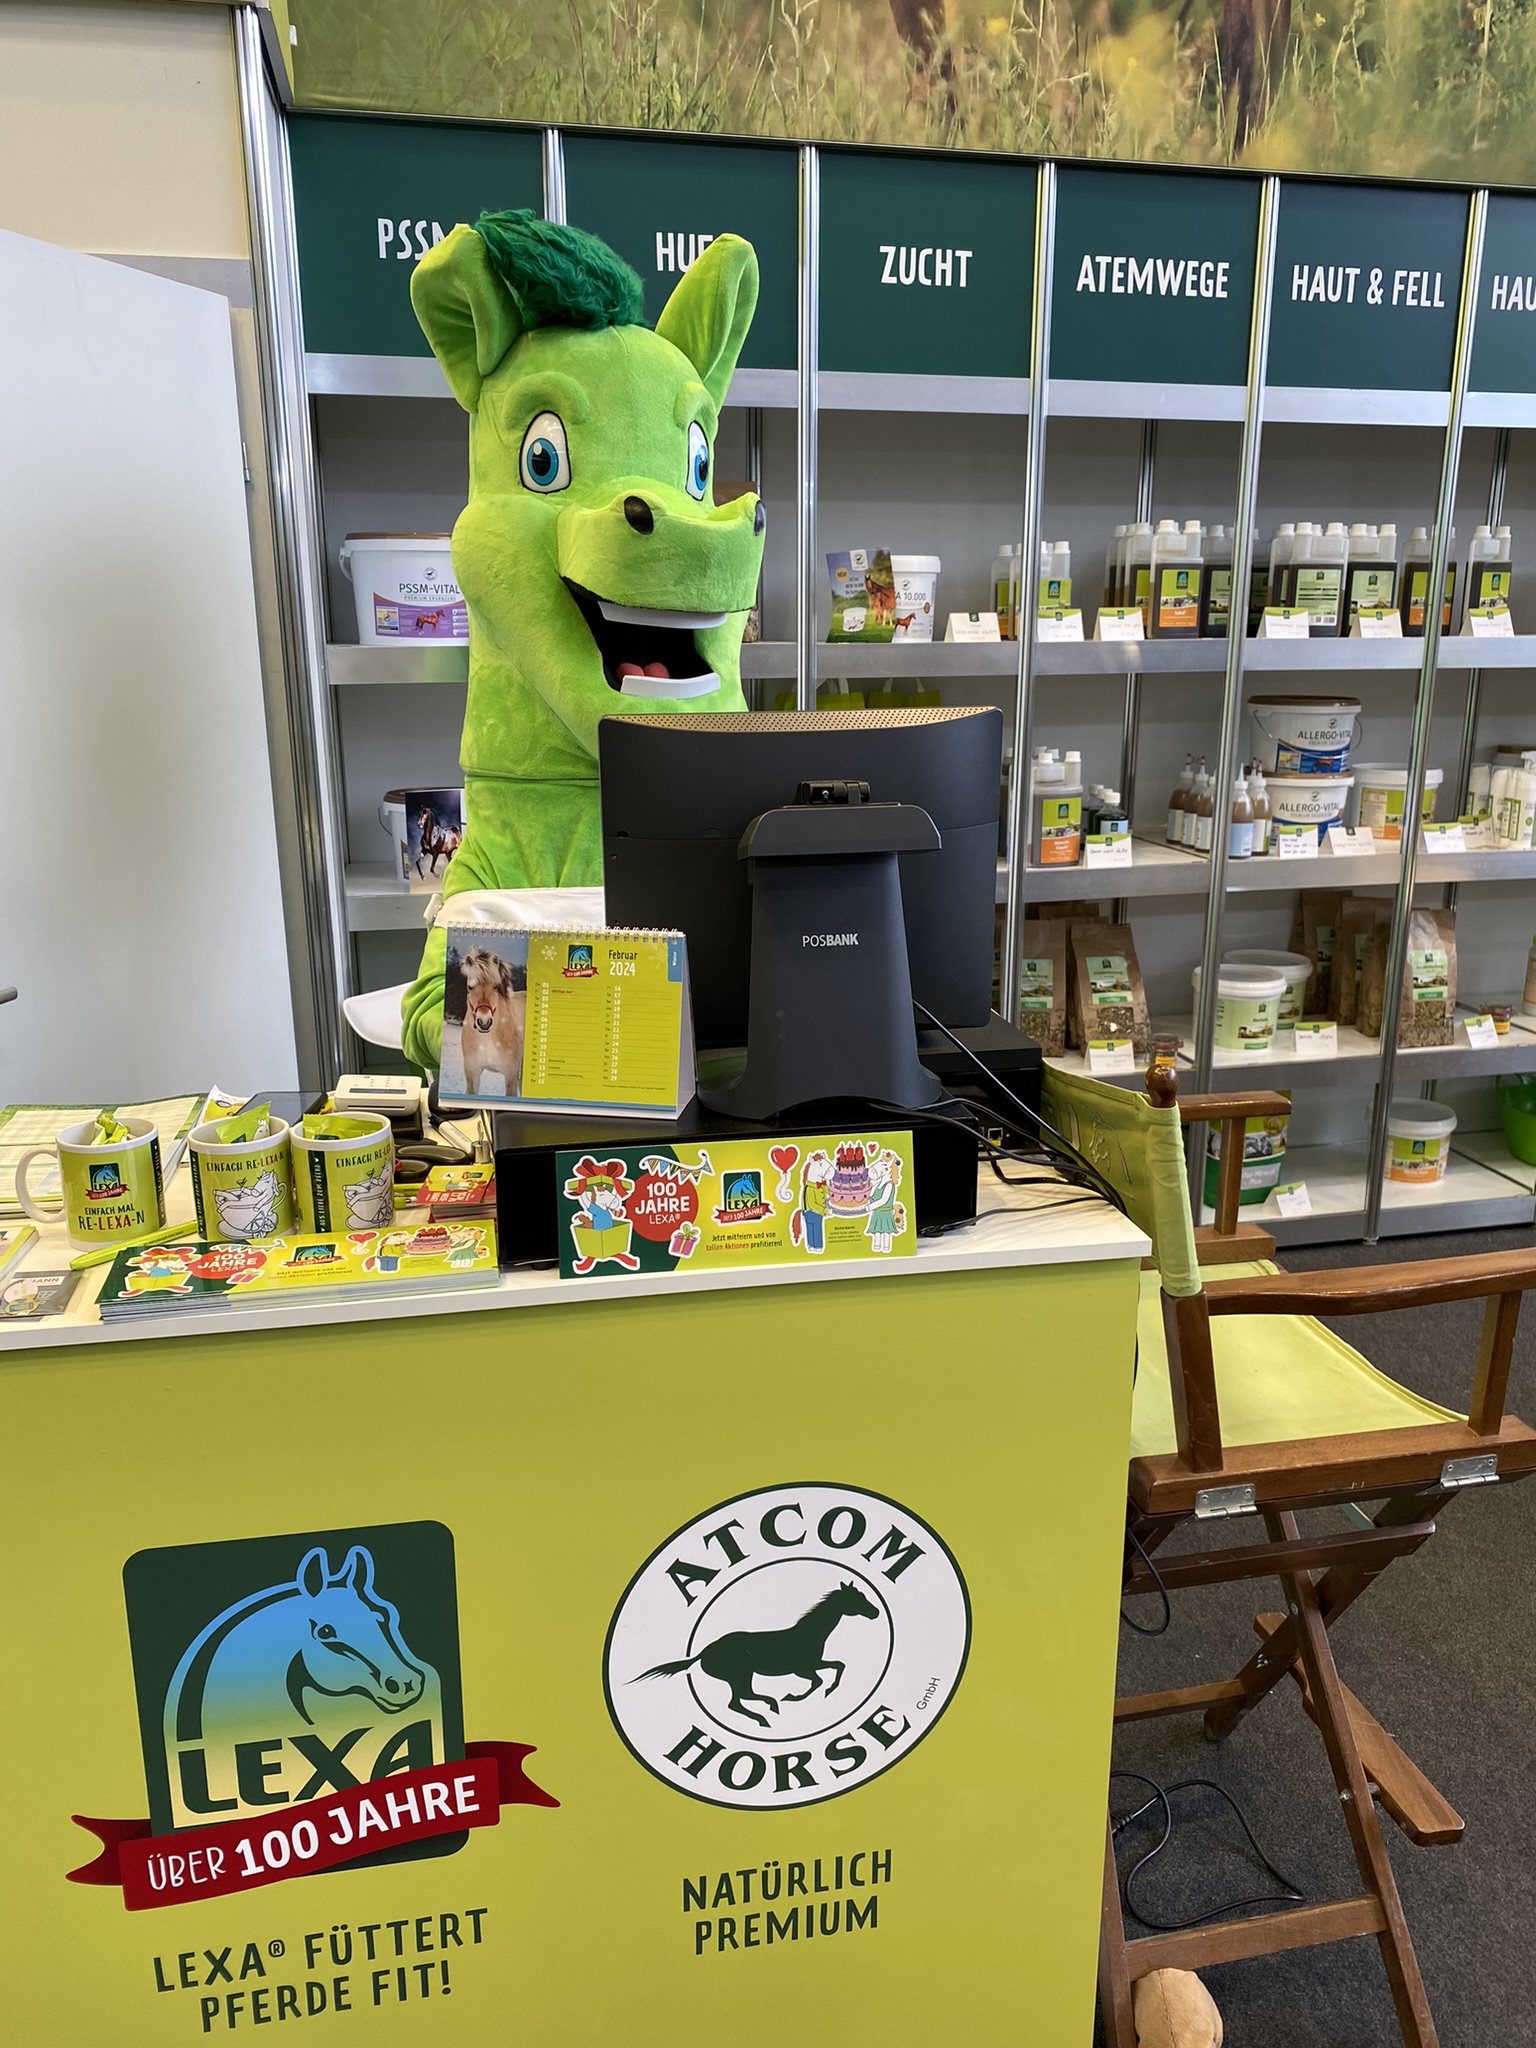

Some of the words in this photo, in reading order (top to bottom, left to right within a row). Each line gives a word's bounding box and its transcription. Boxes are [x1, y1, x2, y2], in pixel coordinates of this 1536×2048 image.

[879, 245, 974, 288] ZUCHT
[1077, 254, 1231, 299] ATEMWEGE
[1291, 265, 1361, 304] HAUT
[1366, 268, 1385, 306] &
[1392, 270, 1446, 309] FELL
[399, 582, 460, 595] PSSM-VITAL
[802, 933, 859, 947] POSBANK
[608, 949, 638, 960] Februar
[609, 961, 636, 976] 2024
[206, 1161, 243, 1172] EINFACH
[336, 1154, 372, 1168] EINFACH
[94, 1182, 118, 1191] LEXA
[647, 1182, 677, 1197] 100
[85, 1207, 115, 1215] EINFACH
[118, 1203, 135, 1213] MAL
[635, 1196, 690, 1215] JAHRE
[728, 1199, 758, 1210] LEXA
[79, 1210, 145, 1231] RE-LEXA-N
[733, 1211, 744, 1220] 100
[745, 1207, 764, 1217] JAHRE
[712, 1234, 726, 1242] Jetzt
[727, 1232, 753, 1241] mitfeiern
[754, 1231, 765, 1239] und
[706, 1244, 723, 1252] tollen
[724, 1242, 750, 1250] Aktionen
[198, 1257, 257, 1269] JAHRE
[213, 1253, 246, 1261] 100
[664, 1502, 926, 1607] ATCOM
[916, 1676, 941, 1711] GmbH
[663, 1704, 911, 1793] HORSE
[177, 1719, 433, 1815] LEXA
[146, 1846, 226, 1891] ÜBER
[234, 1819, 320, 1878] 100
[329, 1774, 481, 1846] JAHRE
[682, 1848, 893, 1912] NATÜRLICH
[696, 1895, 879, 1956] PREMIUM
[304, 1907, 488, 1971] FÜTTERT
[200, 1976, 353, 2033] PFERDE
[372, 1959, 453, 2006] FIT!
